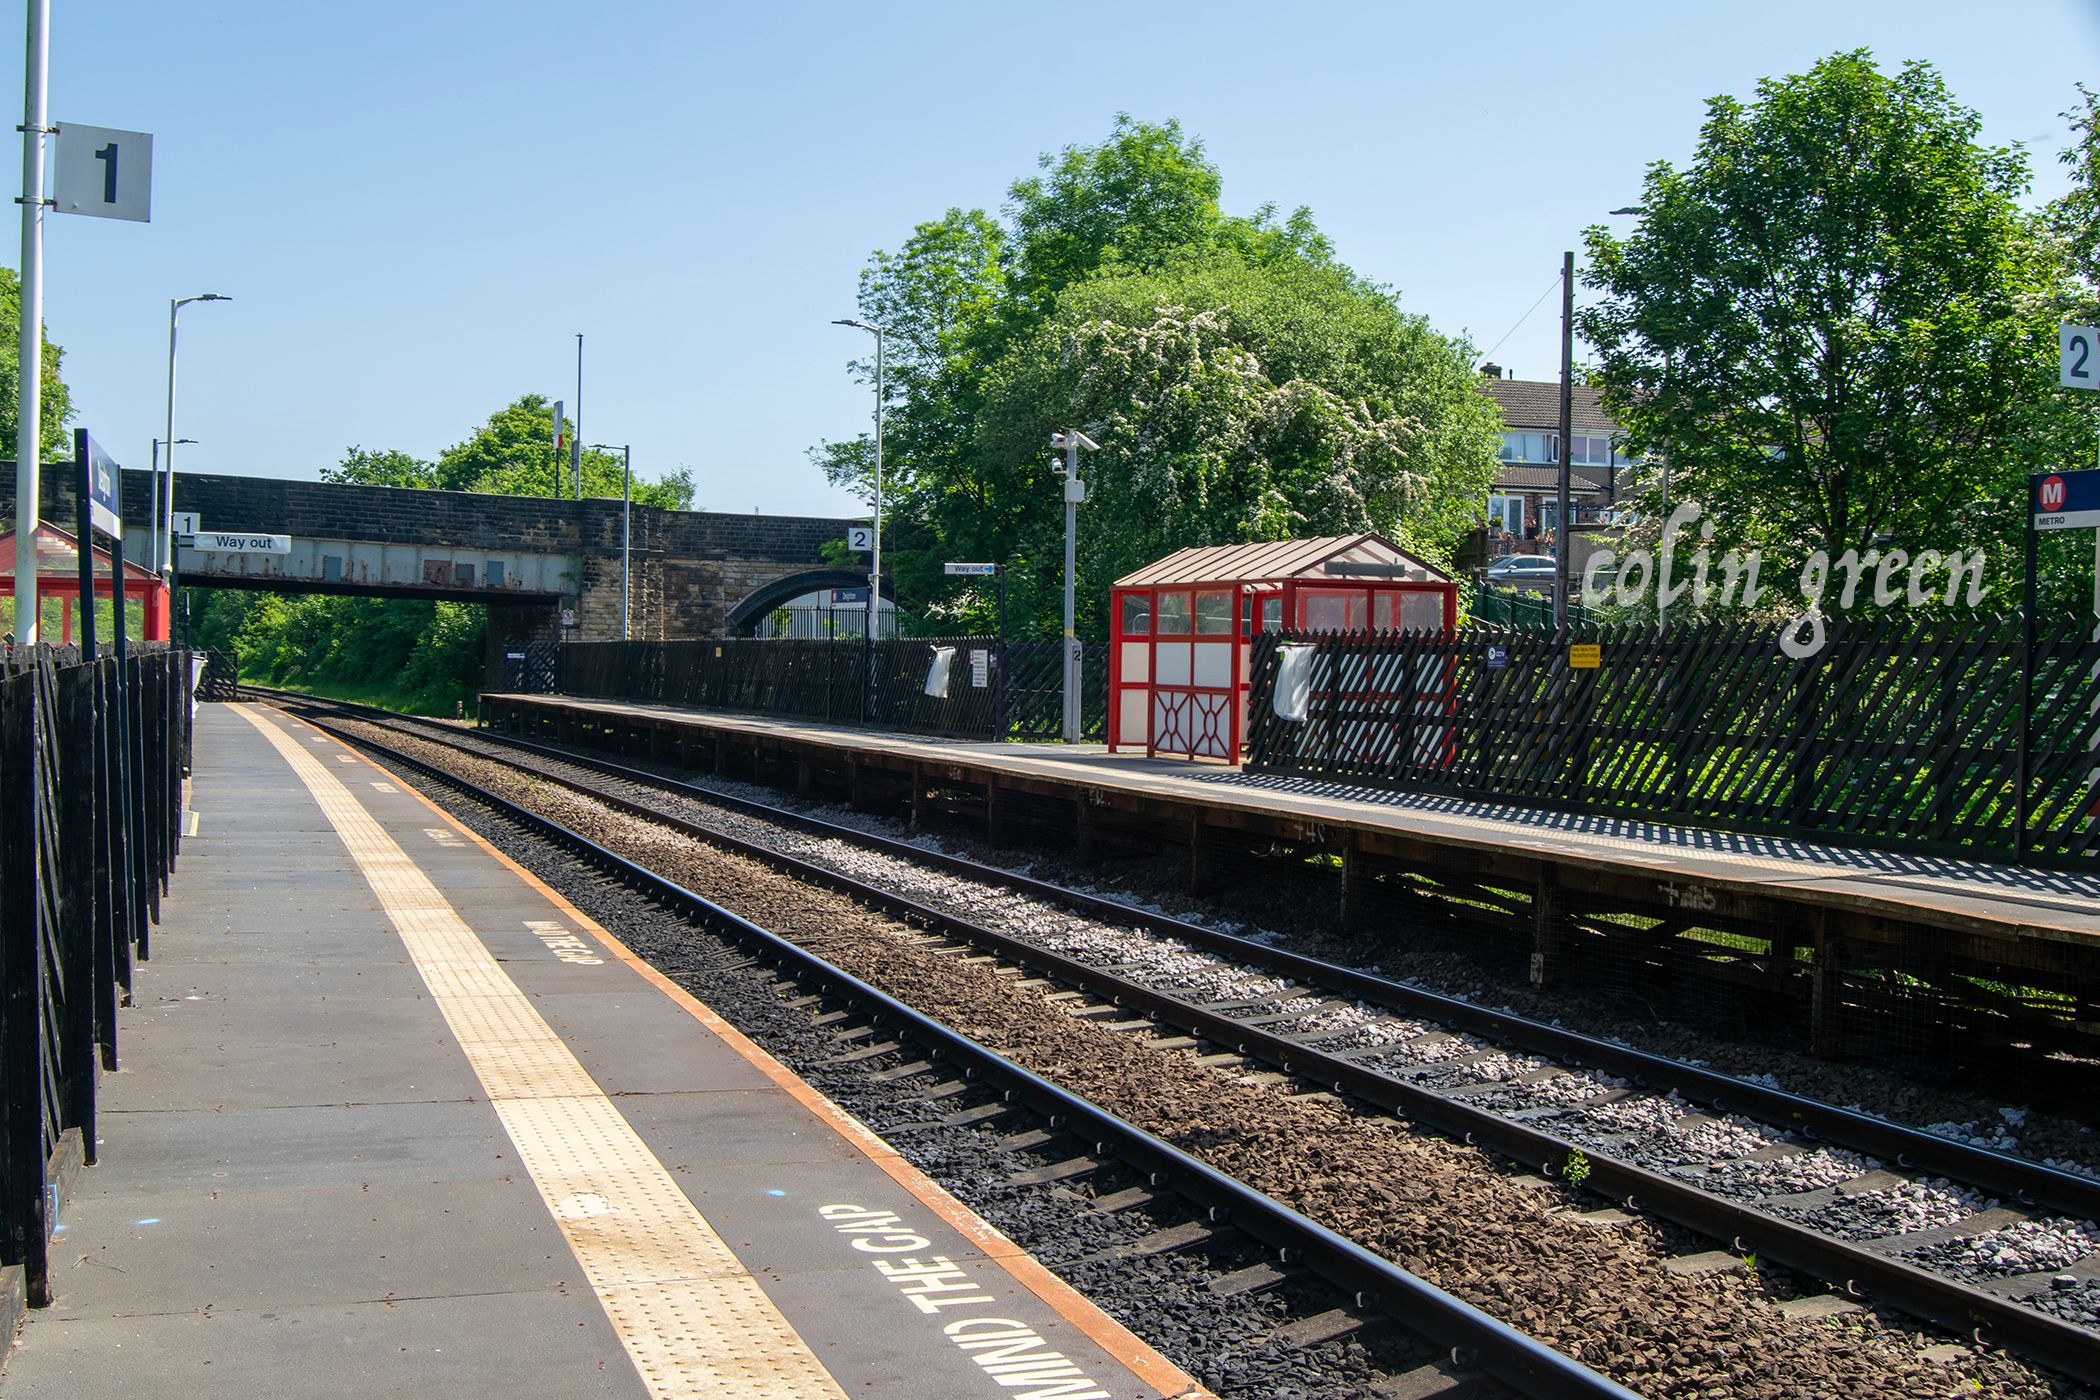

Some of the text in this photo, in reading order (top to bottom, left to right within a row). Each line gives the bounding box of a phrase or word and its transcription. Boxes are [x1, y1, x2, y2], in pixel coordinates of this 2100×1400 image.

[95, 143, 118, 203] 1
[2069, 335, 2089, 378] 2
[2043, 483, 2062, 504] M
[184, 516, 191, 533] 1
[2038, 516, 2065, 526] METRO
[216, 536, 272, 549] Way out
[854, 531, 866, 547] 2
[954, 565, 969, 573] Way
[539, 936, 588, 949] THE
[552, 949, 604, 965] GAP
[818, 1204, 1111, 1400] MIND THE GAP
